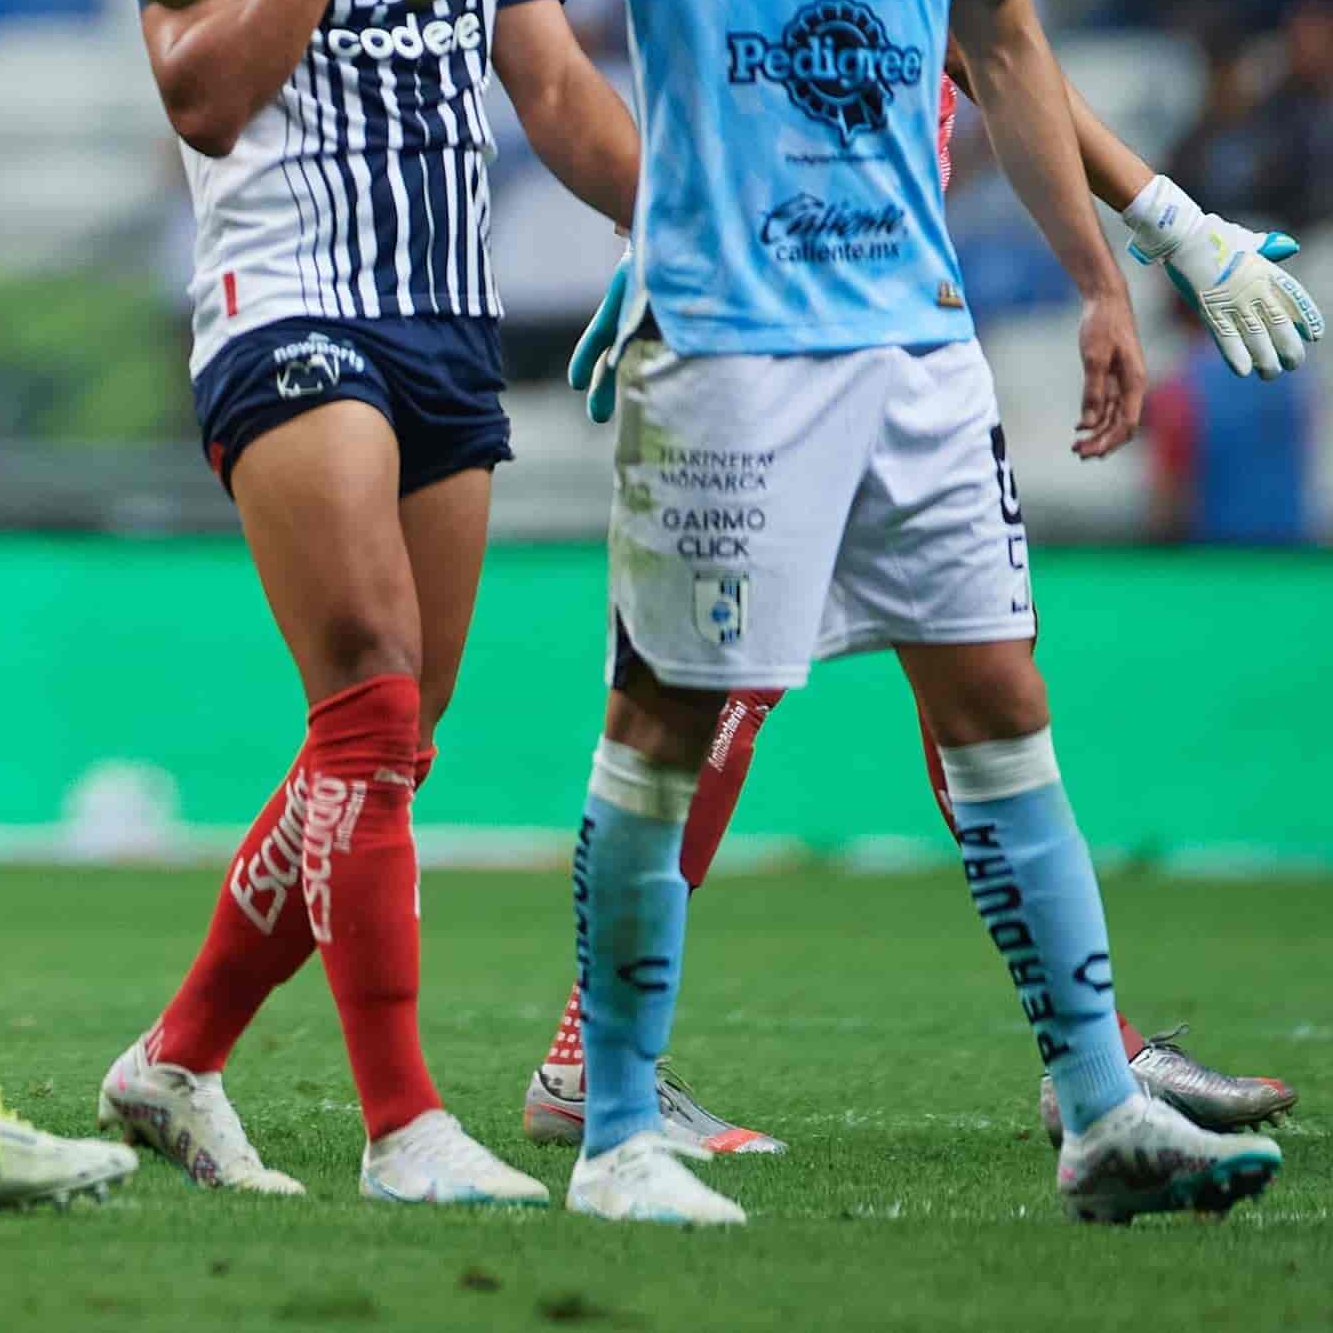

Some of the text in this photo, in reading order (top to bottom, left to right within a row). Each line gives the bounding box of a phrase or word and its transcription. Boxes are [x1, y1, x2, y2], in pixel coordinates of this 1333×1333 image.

[727, 31, 922, 87] Pedigree
[676, 535, 750, 558] CLICK
[957, 823, 1072, 1066] PERDURA
